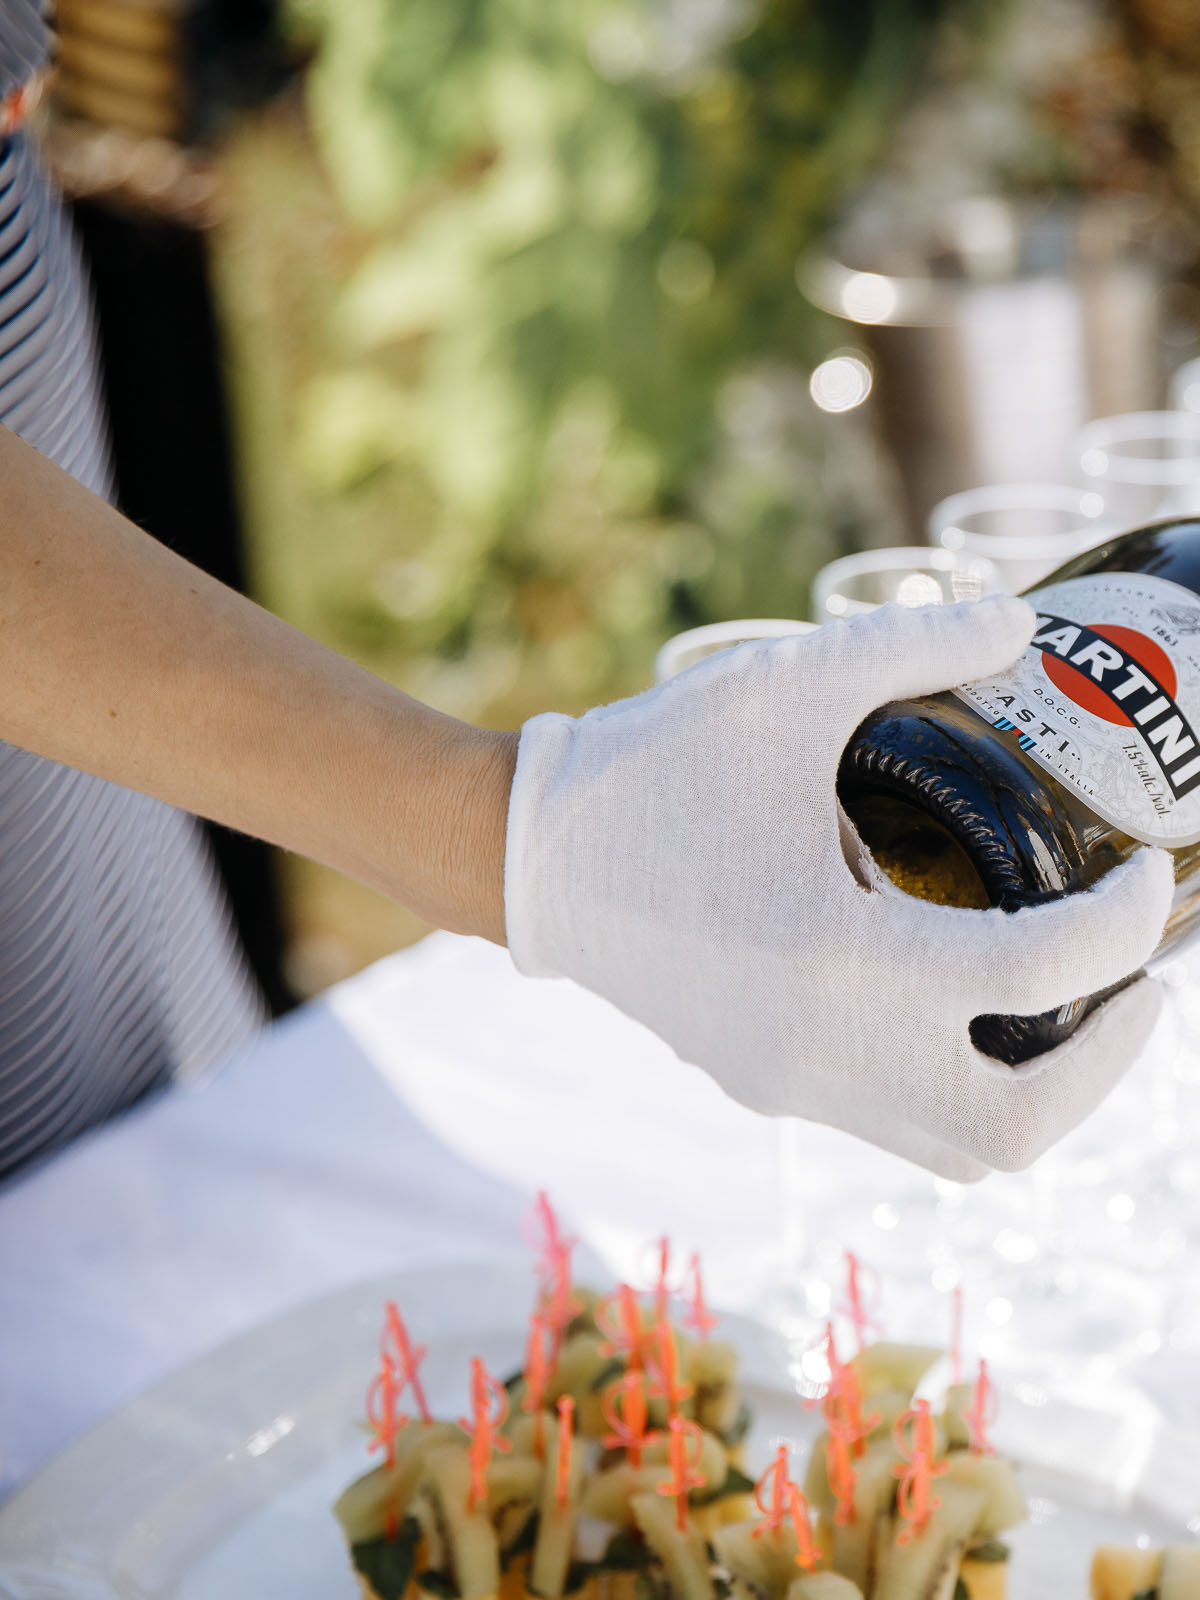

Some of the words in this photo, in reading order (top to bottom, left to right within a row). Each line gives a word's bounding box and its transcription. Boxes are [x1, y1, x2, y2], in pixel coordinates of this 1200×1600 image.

[1152, 625, 1178, 647] 1863
[995, 695, 1070, 752] ASTI
[1033, 688, 1081, 729] D.O.C.G.
[1039, 748, 1052, 760] IN
[1058, 763, 1094, 796] ITALIA
